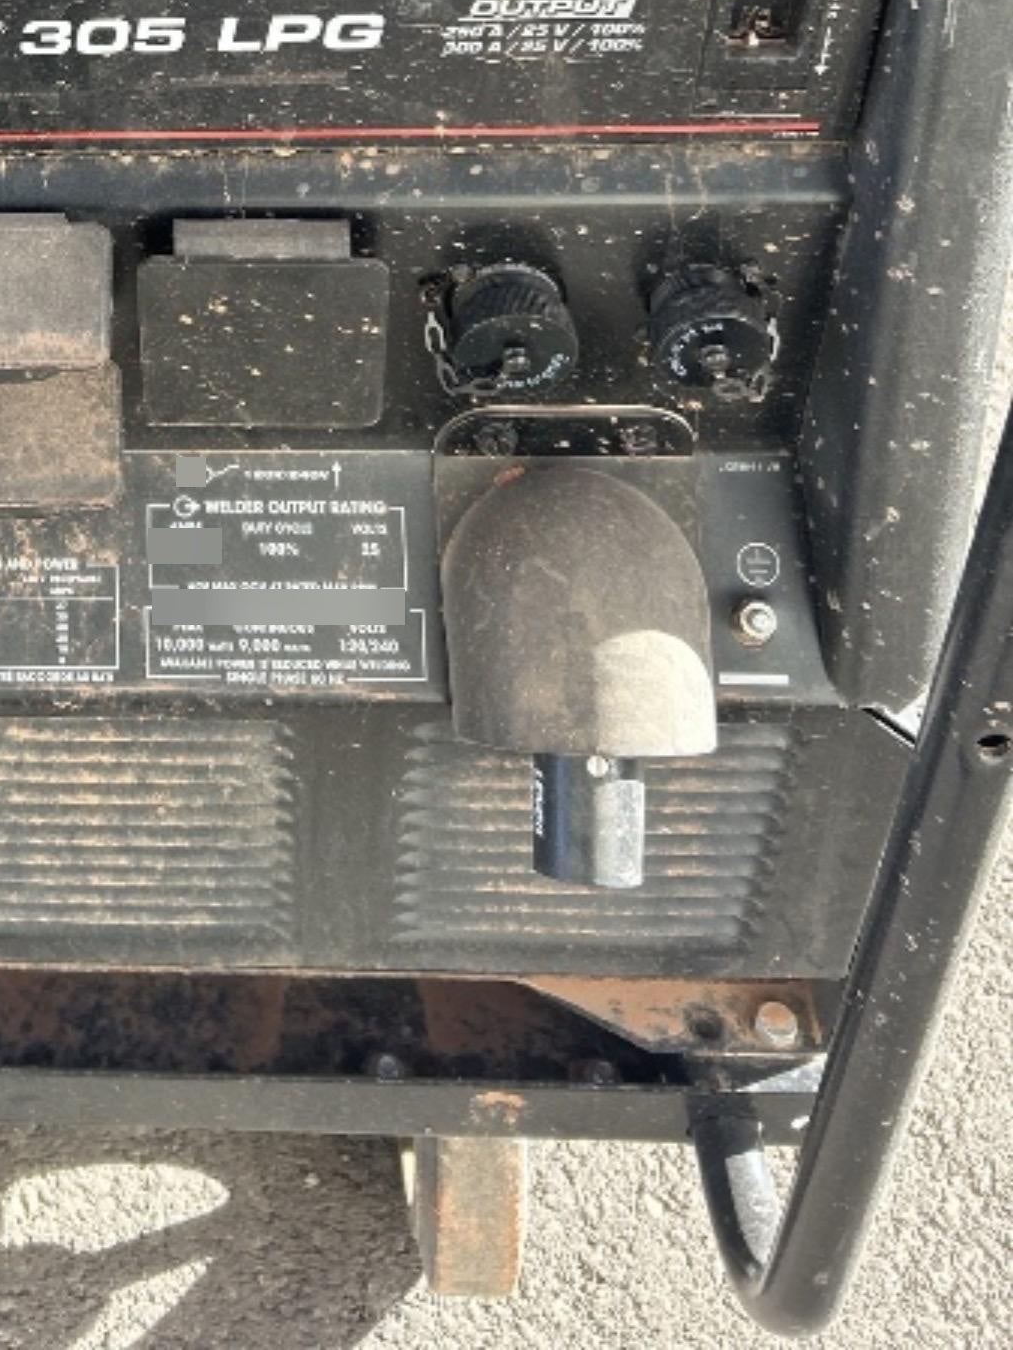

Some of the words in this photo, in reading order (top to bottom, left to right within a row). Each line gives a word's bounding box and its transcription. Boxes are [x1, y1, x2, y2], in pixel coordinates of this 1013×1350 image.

[19, 16, 186, 57] 305
[217, 13, 386, 52] LPG
[204, 501, 264, 514] WELDER
[268, 501, 326, 514] OUTPUT
[331, 502, 387, 515] RATING
